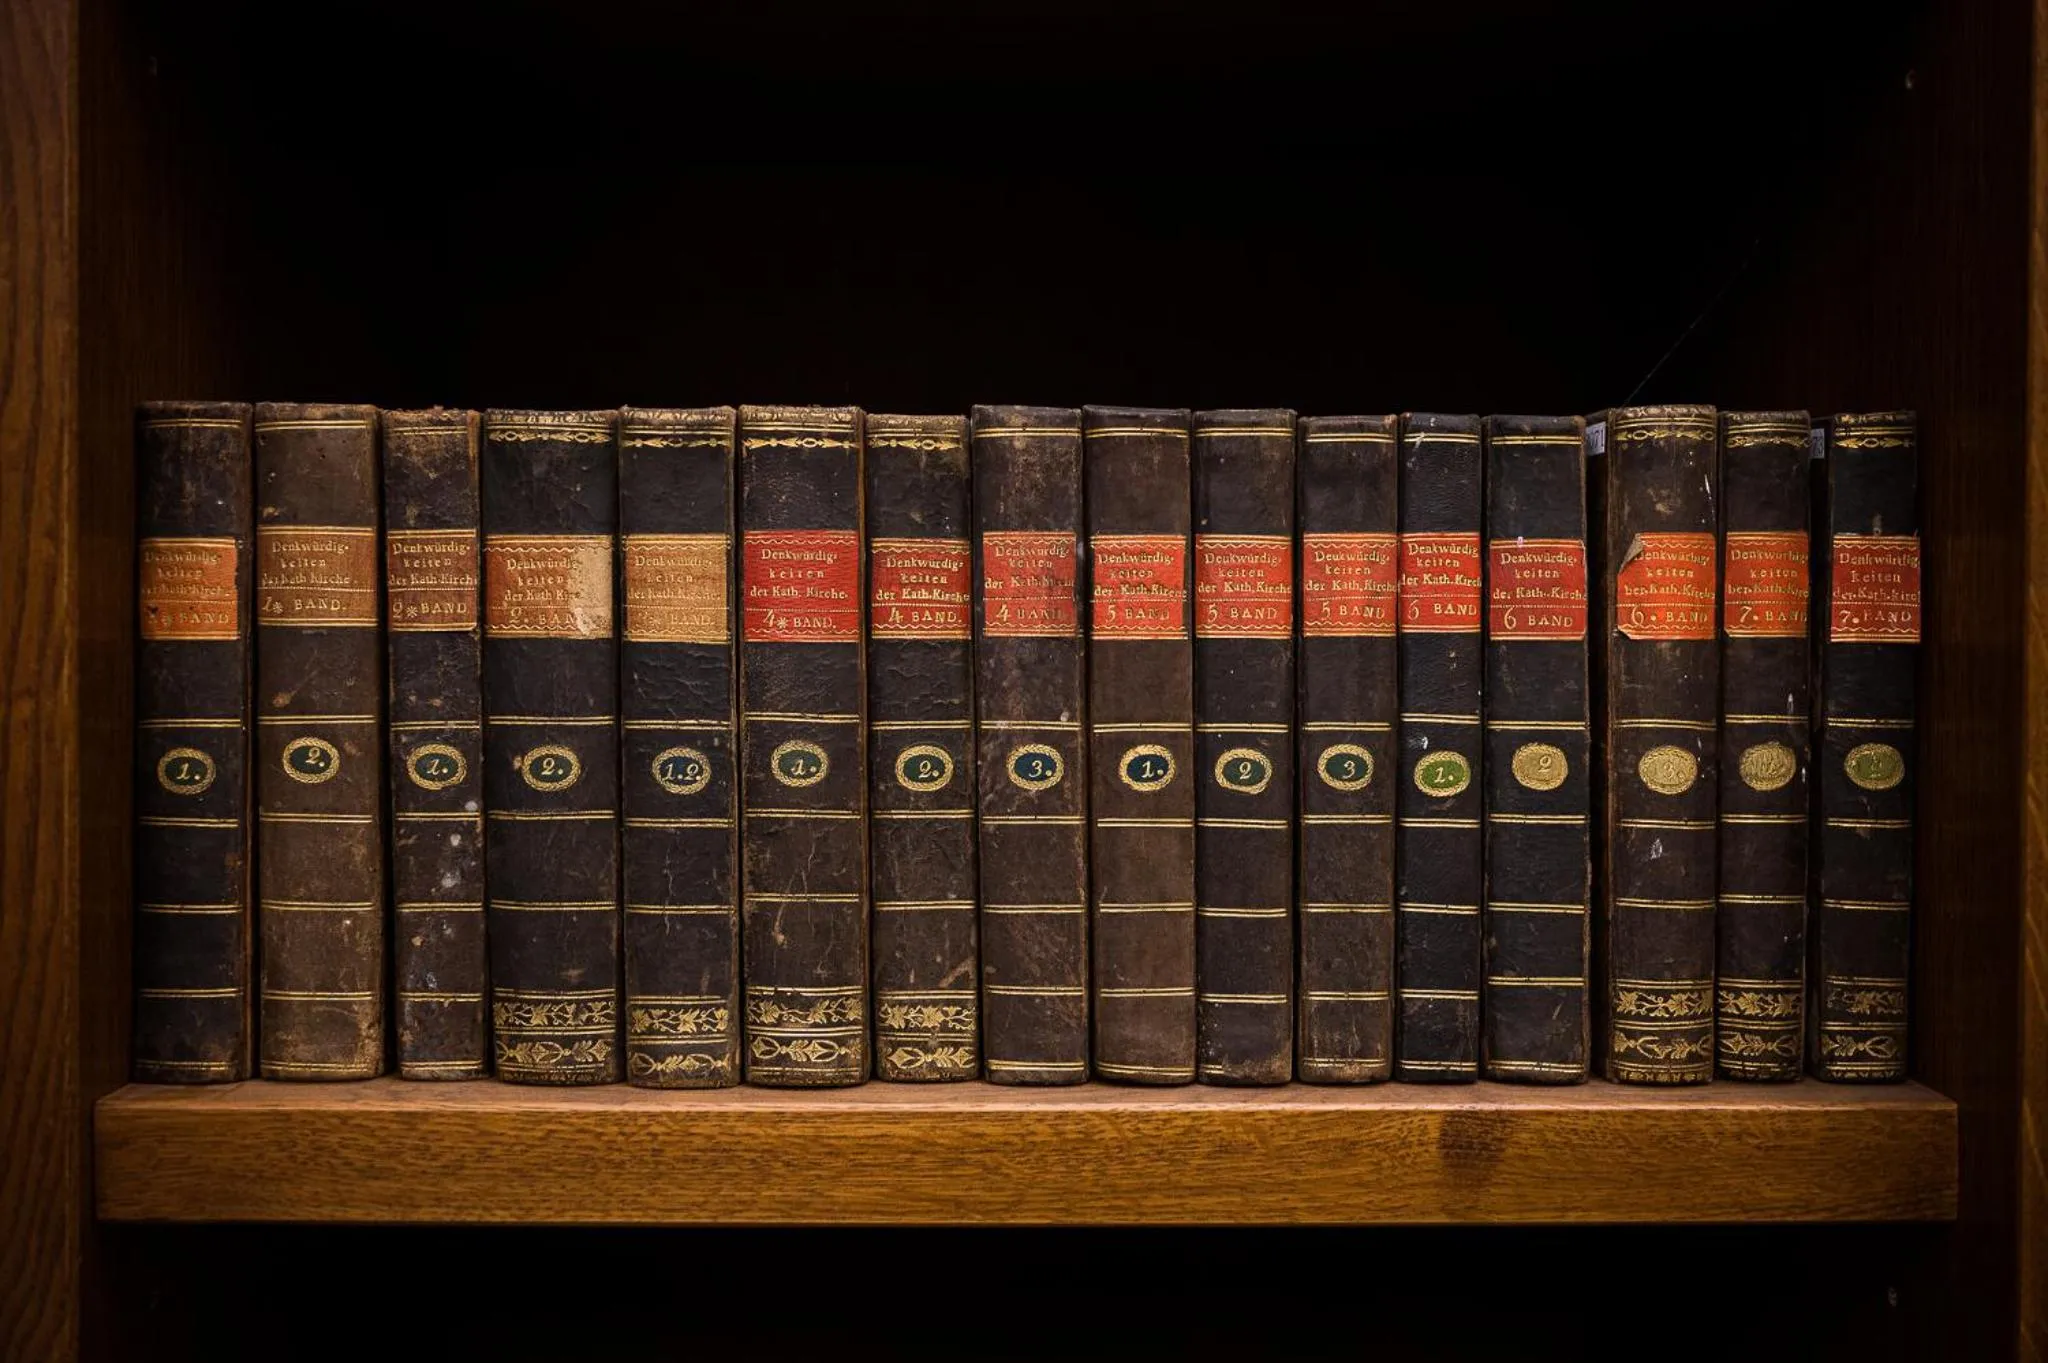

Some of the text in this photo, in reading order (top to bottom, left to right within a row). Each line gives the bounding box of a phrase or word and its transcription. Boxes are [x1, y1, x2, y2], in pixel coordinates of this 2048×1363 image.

[750, 586, 769, 597] der
[984, 577, 1004, 589] der
[1094, 584, 1113, 596] der
[1198, 582, 1217, 593] der
[1305, 580, 1326, 591] der
[505, 590, 524, 601] der
[876, 589, 896, 600] der
[996, 604, 1011, 622] 4
[1106, 605, 1116, 623] 5
[1208, 602, 1278, 623] 5 BAND
[1321, 600, 1386, 621] 5 BAND
[1408, 599, 1477, 621] 6 BAND
[1504, 606, 1573, 629] 6 BAND
[1666, 611, 1708, 623] BAND
[305, 747, 330, 767] 2.
[1538, 755, 1552, 773] 2
[541, 757, 564, 776] 2.
[918, 760, 940, 779] 2.
[1028, 760, 1053, 778] 3.
[1141, 760, 1164, 778] 1.
[1239, 761, 1252, 780] 2
[1343, 760, 1355, 779] 3
[1434, 767, 1455, 783] 1.
